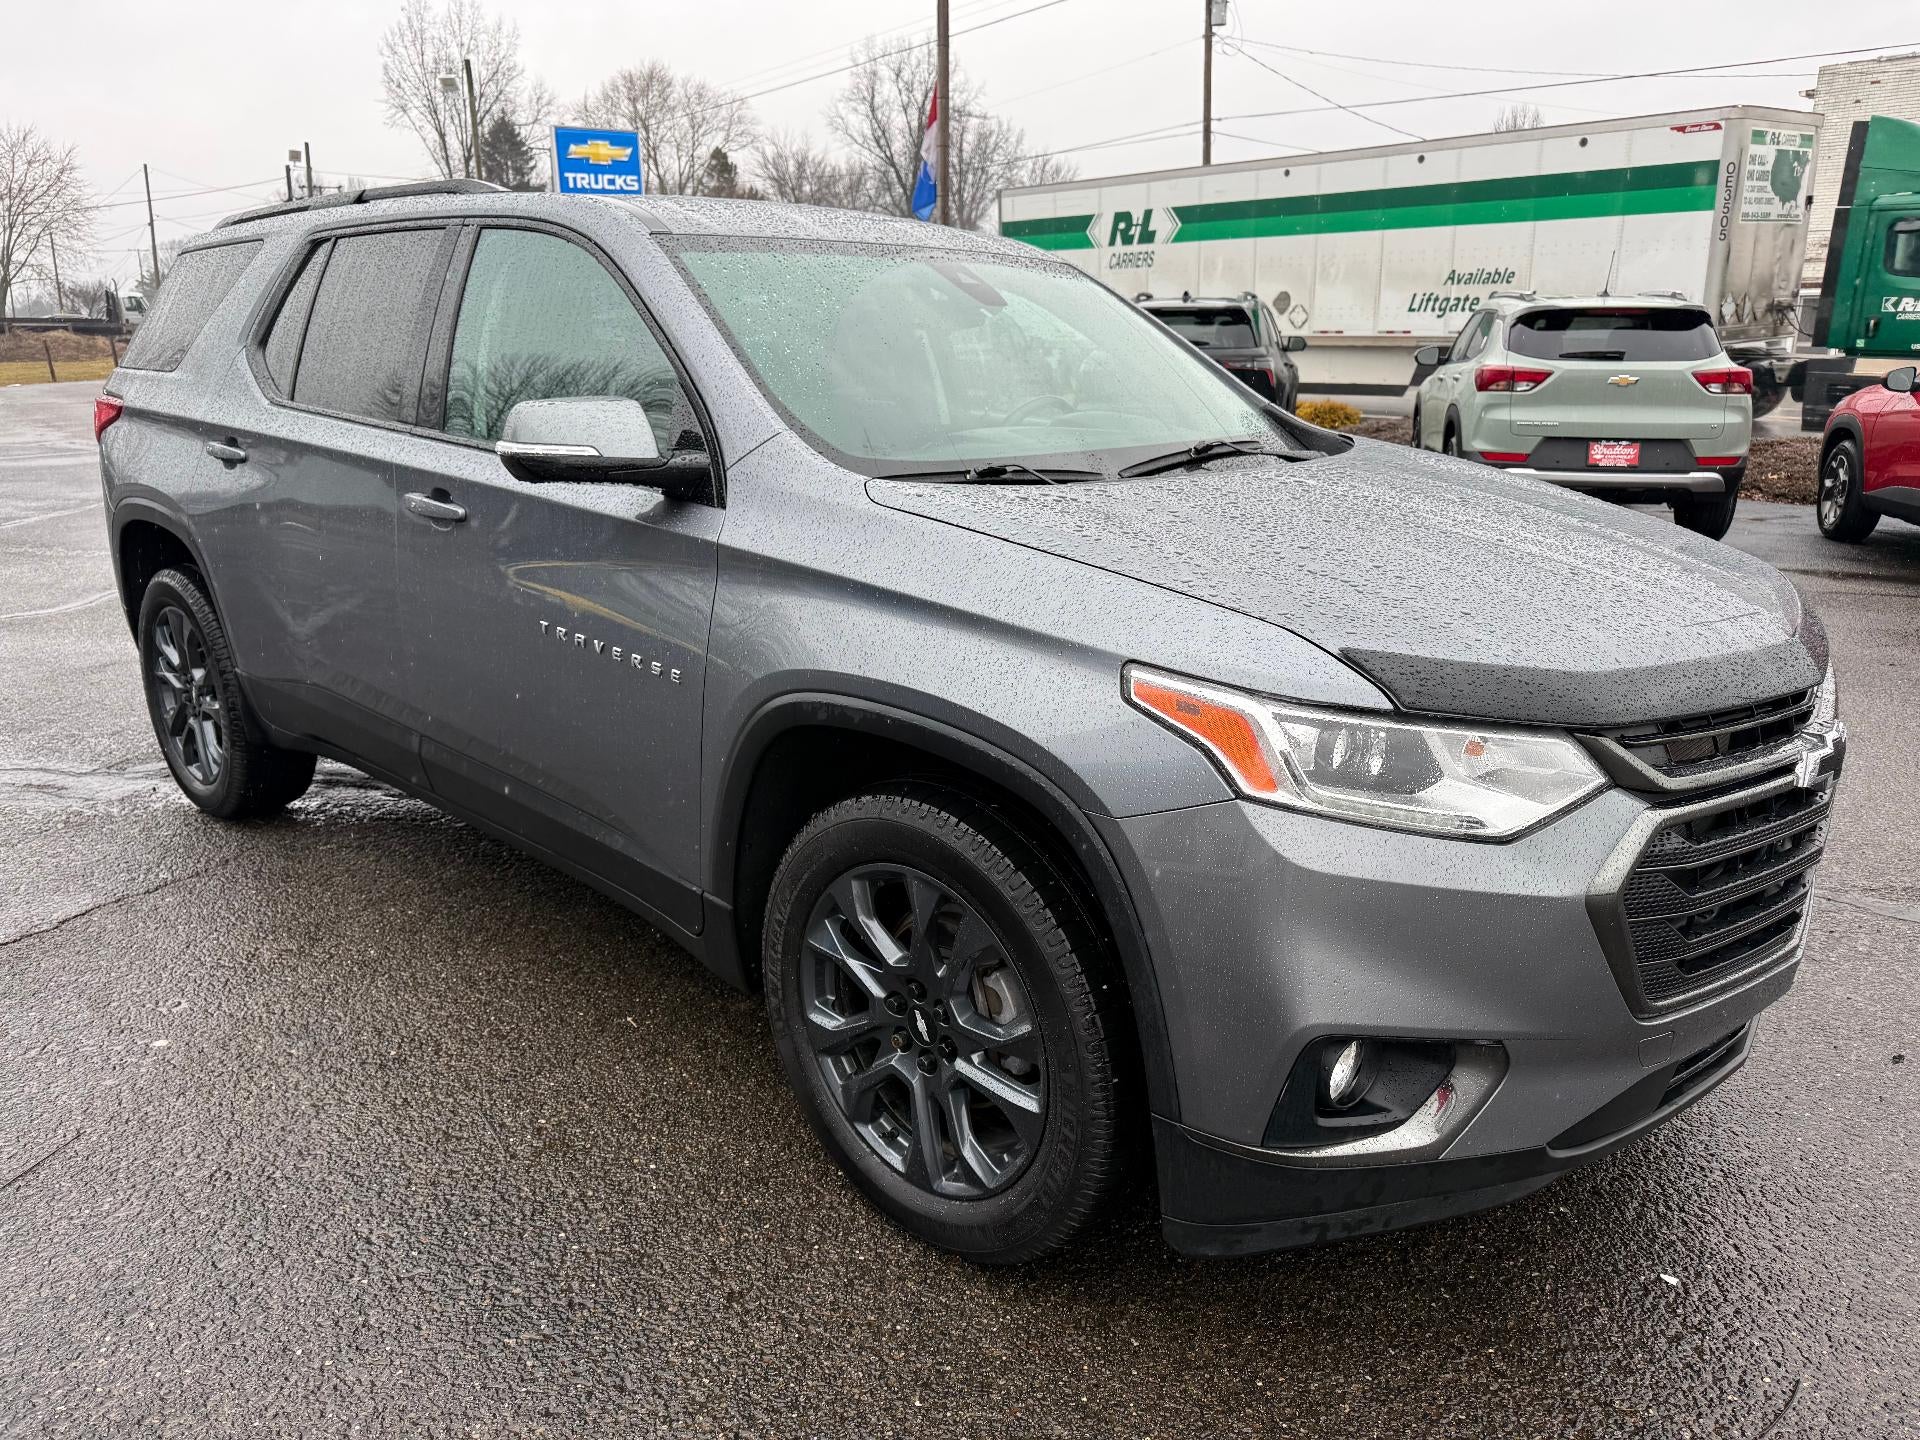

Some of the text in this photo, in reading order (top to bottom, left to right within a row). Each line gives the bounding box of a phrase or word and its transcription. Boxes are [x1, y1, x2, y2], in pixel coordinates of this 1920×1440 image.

[563, 172, 640, 191] TRUCKS
[1109, 251, 1155, 270] CARRIERS
[1443, 267, 1516, 286] Available
[1407, 291, 1481, 318] Liftgate
[1591, 444, 1638, 455] Stratton
[539, 620, 681, 685] TRAVERSE
